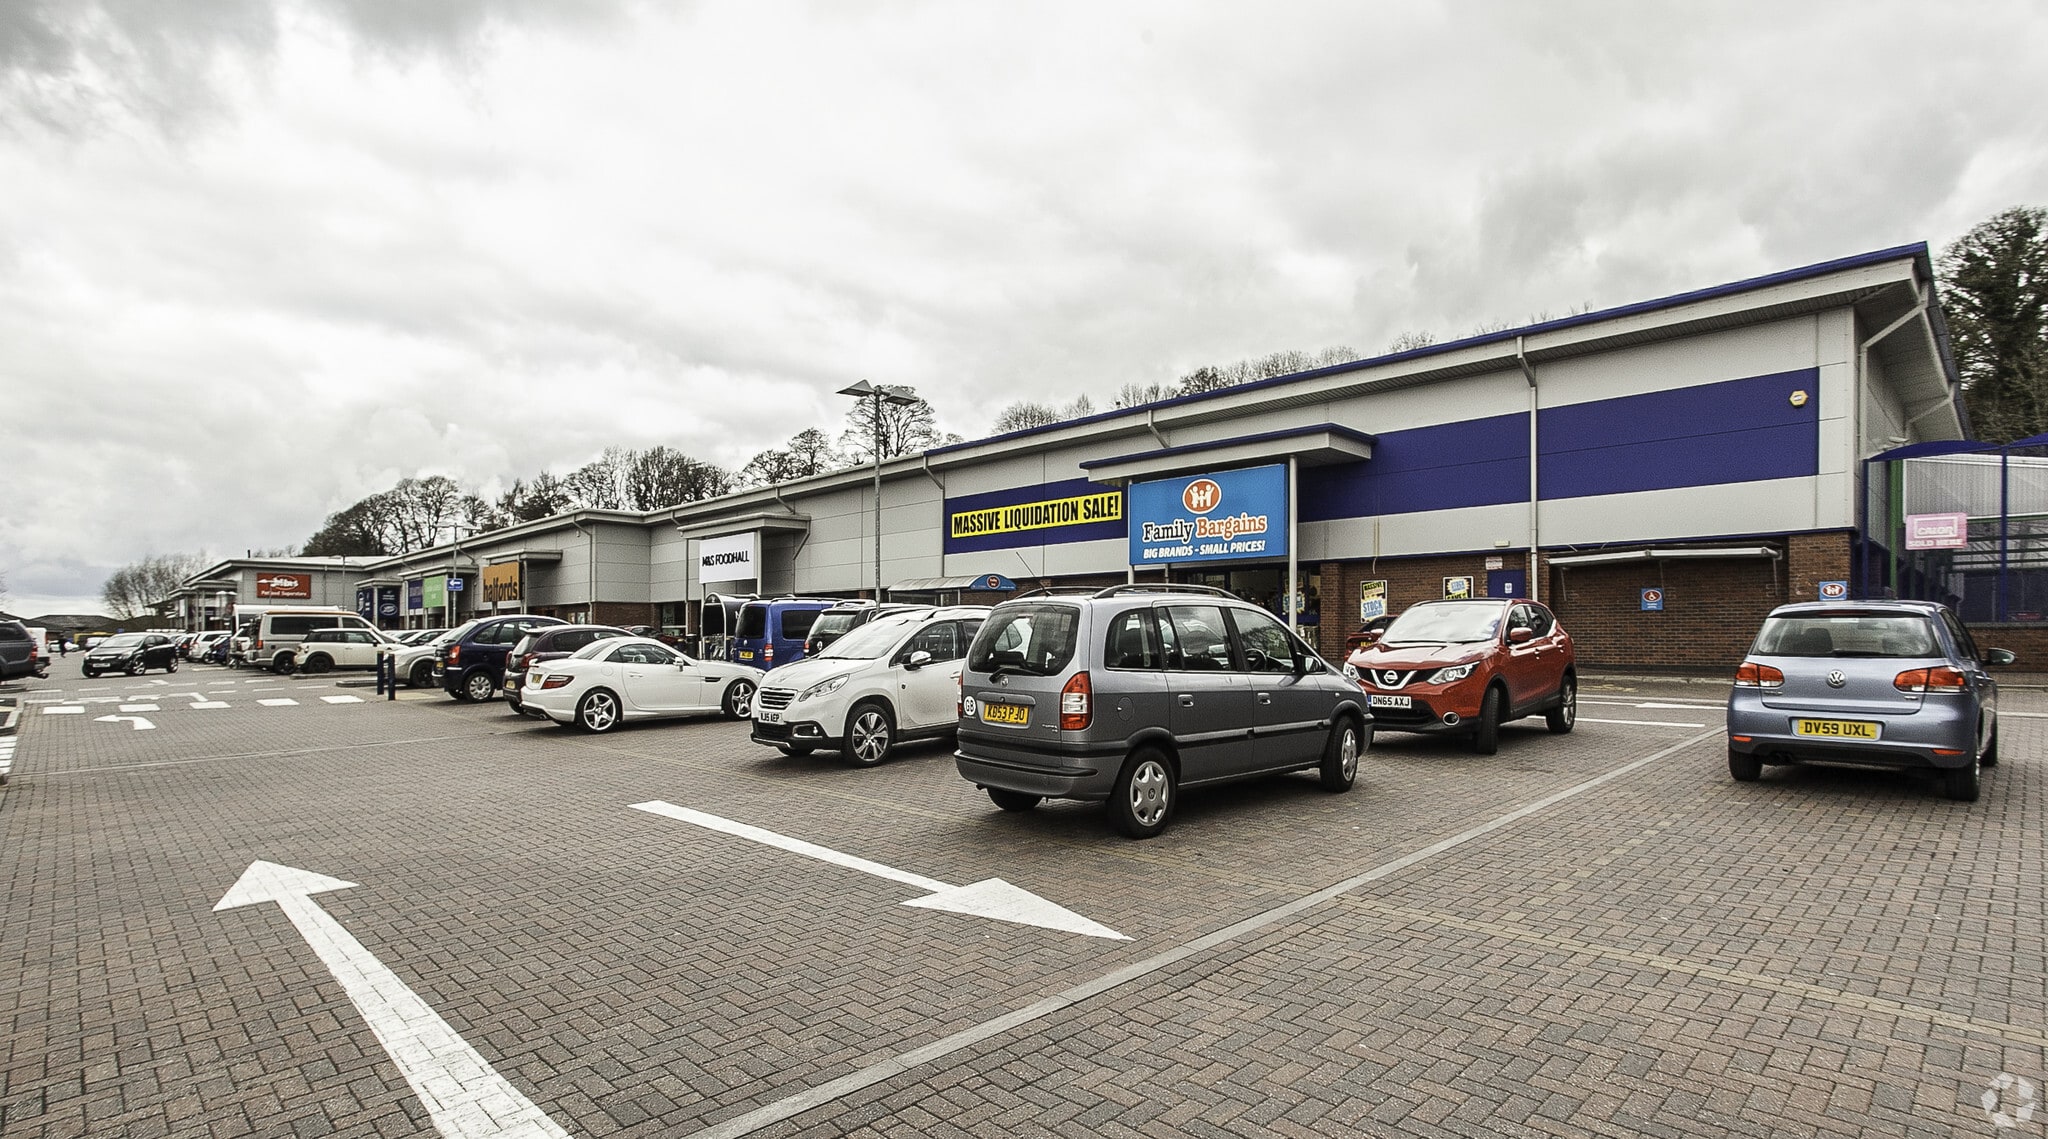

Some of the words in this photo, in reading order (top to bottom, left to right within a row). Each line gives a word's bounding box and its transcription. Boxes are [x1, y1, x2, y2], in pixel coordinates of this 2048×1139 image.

[953, 511, 1000, 535] MASSIVE
[1004, 500, 1079, 529] LIQUIDATION
[1083, 495, 1119, 520] SALE!
[1143, 520, 1193, 543] Family
[1196, 513, 1267, 539] Bargains
[715, 550, 749, 566] FOODHALL
[1143, 548, 1158, 559] BIG
[1158, 545, 1193, 557] BRANDS
[1199, 543, 1228, 555] SMALL
[1230, 540, 1266, 553] PRICES!
[483, 575, 518, 602] halfords
[1363, 600, 1383, 612] STOCK
[1372, 696, 1392, 705] DN65
[1394, 697, 1410, 706] AXJ
[1804, 722, 1839, 735] DV59
[1843, 723, 1870, 737] UXL
